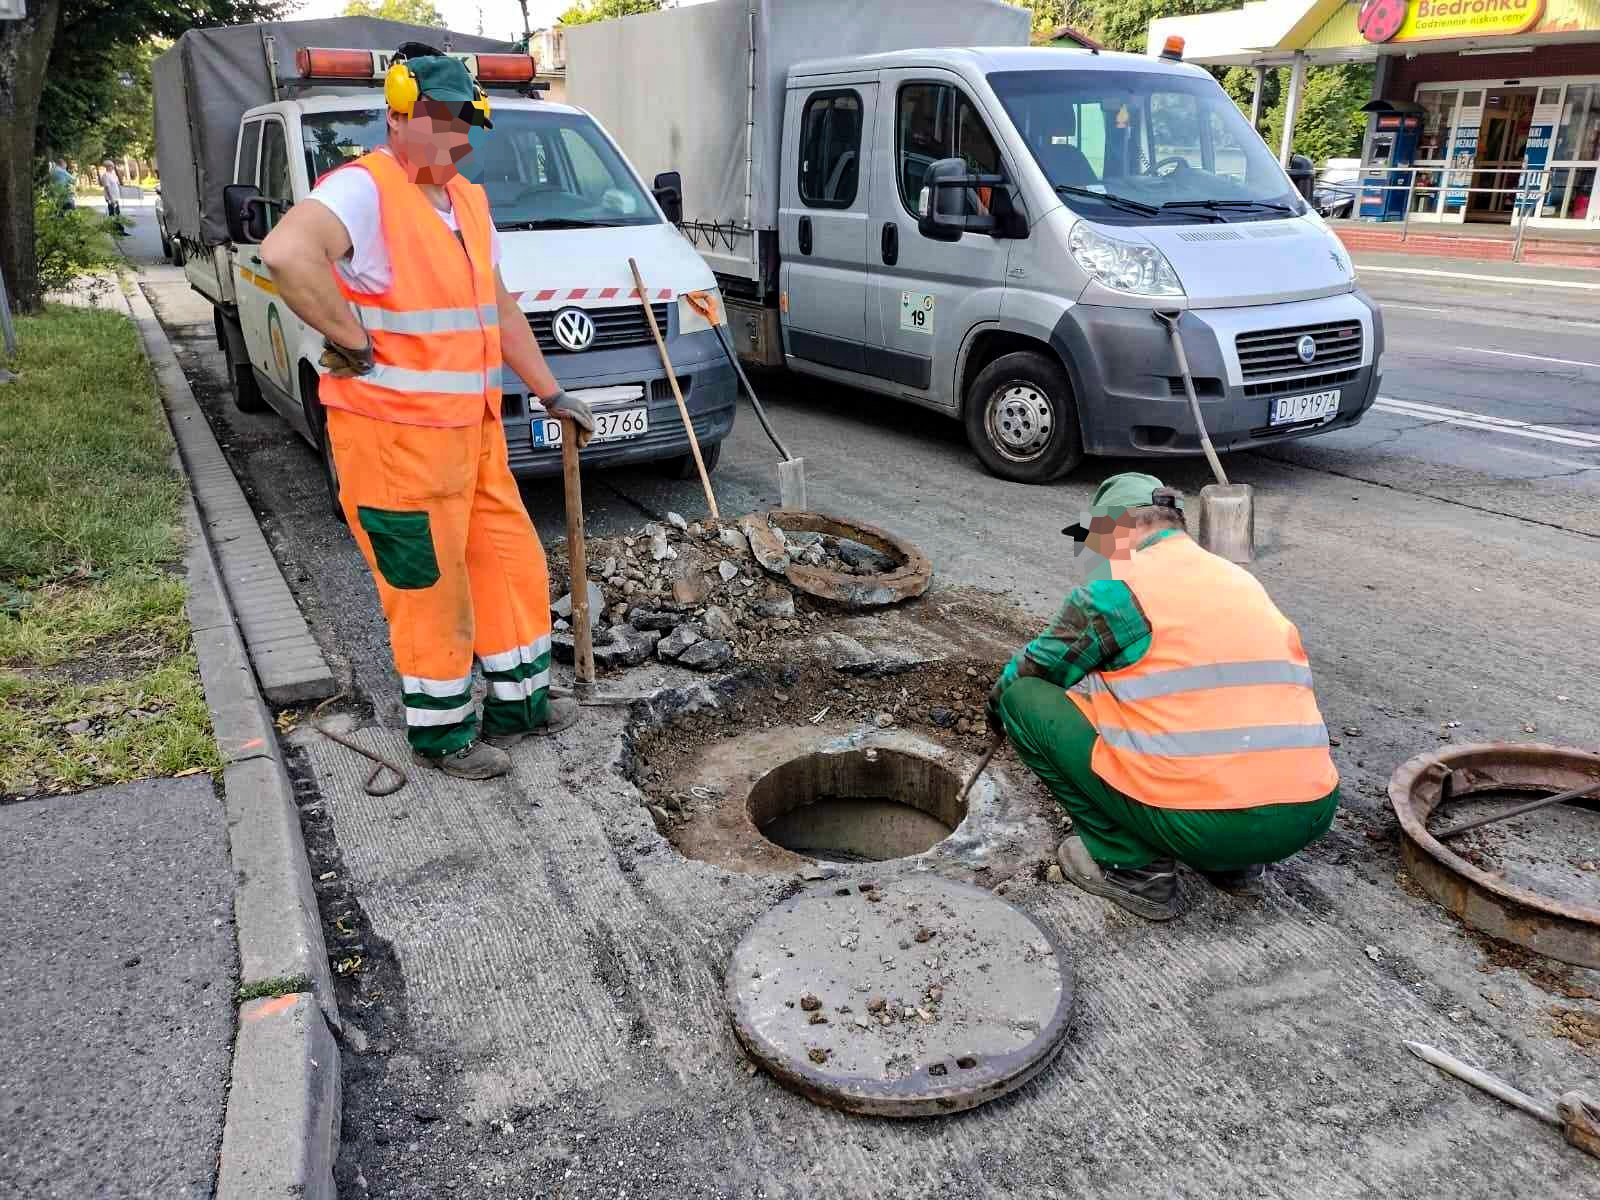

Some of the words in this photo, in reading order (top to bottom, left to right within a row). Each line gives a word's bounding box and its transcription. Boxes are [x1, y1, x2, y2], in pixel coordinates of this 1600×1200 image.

[1417, 0, 1527, 18] Biedronka
[911, 310, 925, 326] 19
[1300, 392, 1336, 416] 9197A
